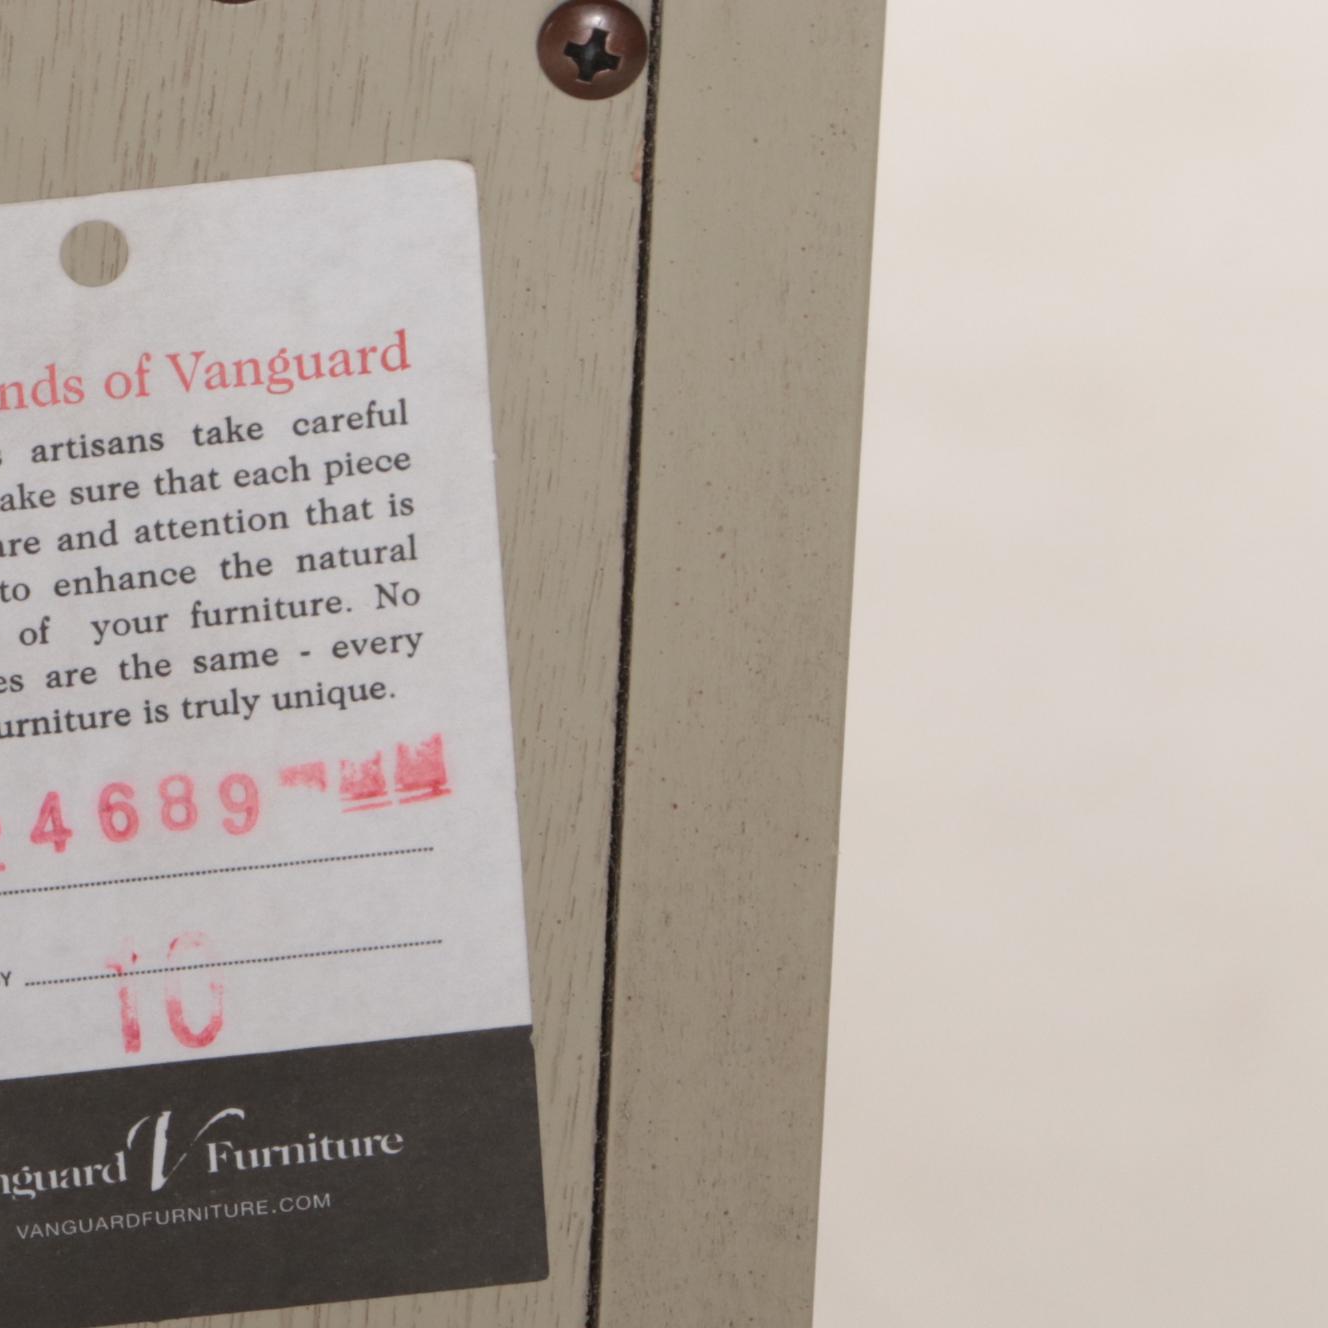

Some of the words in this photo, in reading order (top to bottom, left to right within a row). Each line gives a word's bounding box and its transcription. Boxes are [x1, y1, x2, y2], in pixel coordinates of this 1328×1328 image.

[103, 352, 153, 400] of
[166, 328, 412, 395] Vanguard
[32, 433, 164, 462] artisans
[193, 417, 262, 446] take
[293, 399, 407, 436] careful
[71, 481, 139, 505] sure
[154, 468, 219, 495] that
[234, 456, 309, 487] each
[325, 453, 409, 485] piece
[58, 520, 118, 551] and
[136, 510, 288, 543] attention
[306, 498, 372, 525] that
[390, 494, 413, 517] is
[0, 582, 30, 602] to
[54, 566, 196, 596] enhance
[221, 552, 272, 580] the
[297, 534, 416, 572] natural
[20, 616, 50, 645] of
[91, 614, 168, 645] your
[192, 597, 351, 628] furniture.
[376, 583, 419, 609] No
[46, 667, 96, 688] are
[120, 653, 171, 680] the
[194, 649, 278, 673] same
[332, 633, 422, 658] every
[144, 700, 168, 724] is
[182, 688, 260, 720] truly
[272, 682, 396, 710] unique.
[208, 1133, 403, 1172] Furniture
[13, 1193, 329, 1238] VANGUARDFURNITURE.COM
